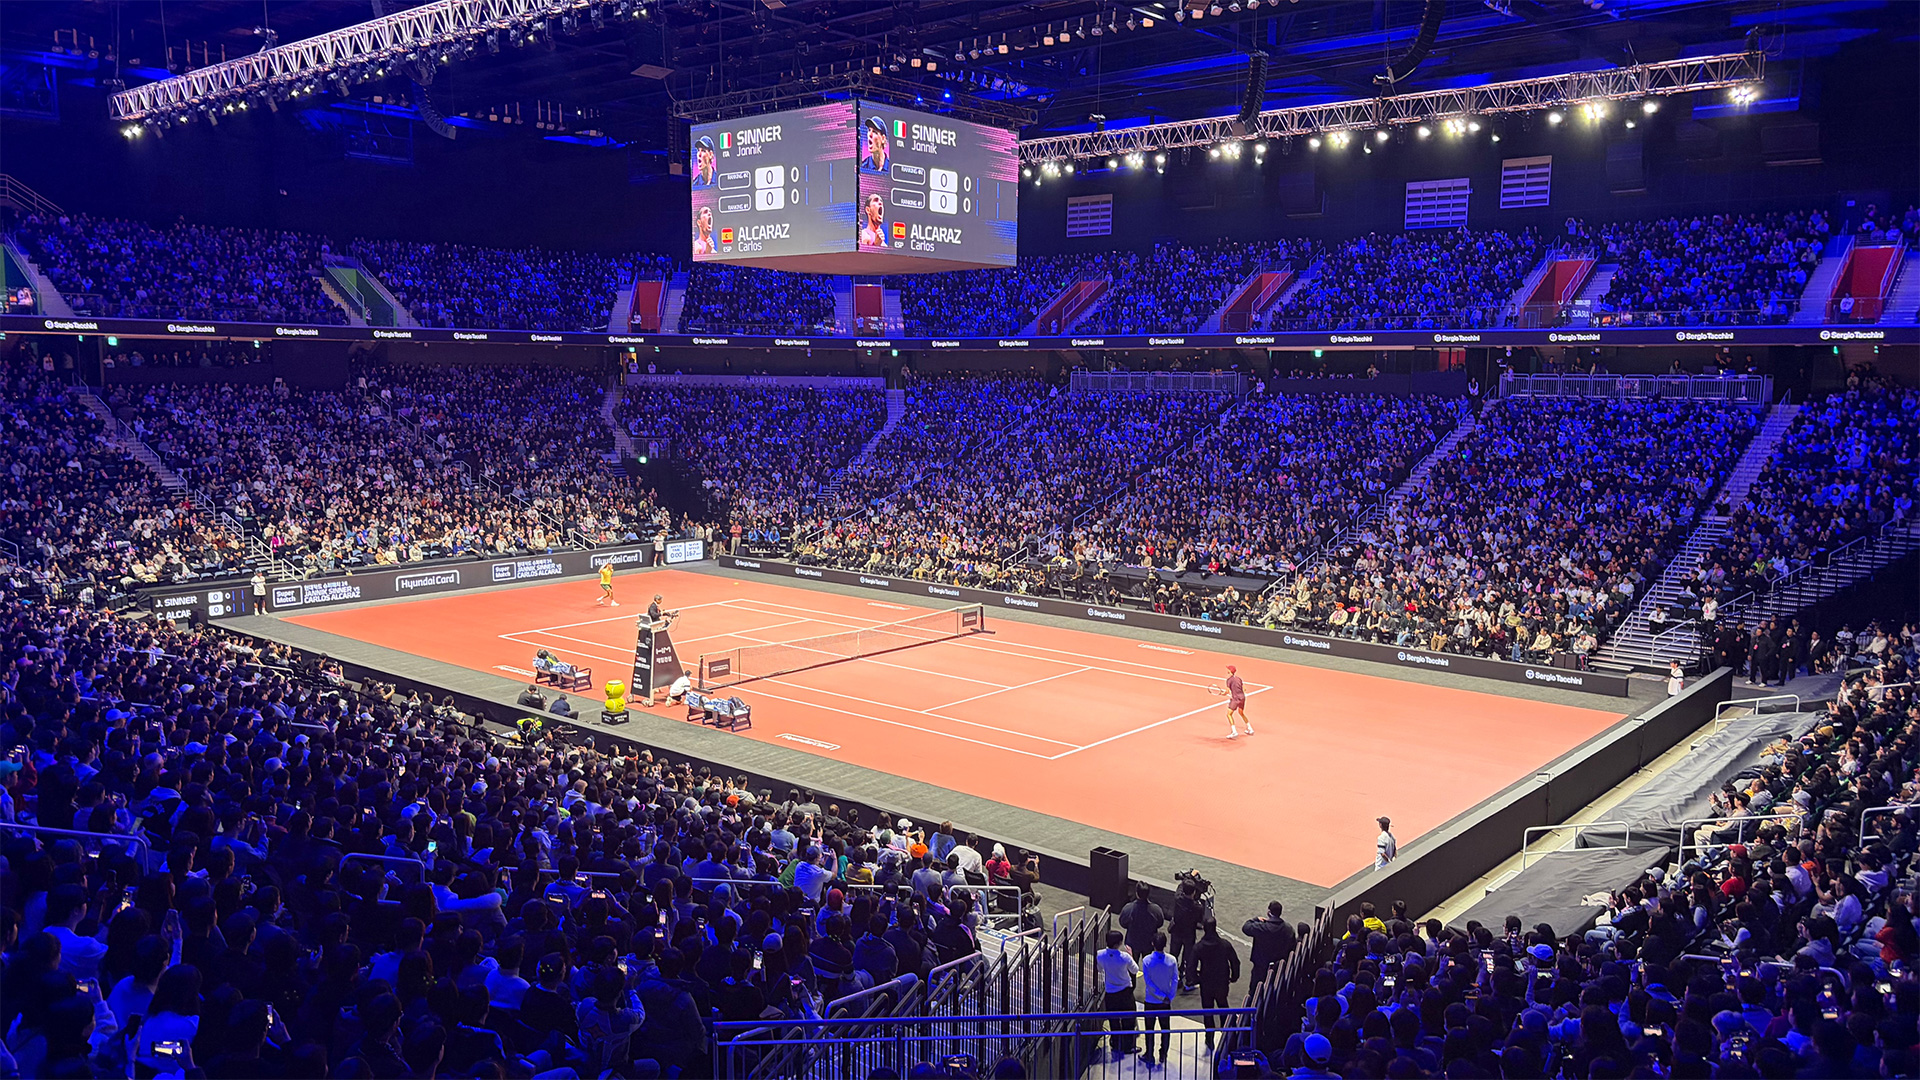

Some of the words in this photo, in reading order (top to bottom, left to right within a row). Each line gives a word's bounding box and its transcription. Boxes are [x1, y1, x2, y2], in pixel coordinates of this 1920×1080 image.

[737, 125, 781, 146] SINNER
[912, 124, 956, 147] SINNER
[737, 144, 762, 156] Jannik
[912, 140, 937, 154] Jannik
[766, 170, 773, 184] 0
[791, 167, 799, 182] 0
[941, 174, 947, 187] 0
[964, 176, 971, 192] 0
[766, 192, 773, 205] 0
[791, 188, 799, 204] 0
[940, 195, 947, 209] 0
[963, 198, 971, 212] 0
[738, 224, 790, 241] ALCARAZ
[910, 224, 961, 244] ALCARAZ
[738, 241, 762, 252] Carlos
[911, 240, 934, 252] Carlos
[54, 322, 72, 330] Sergio
[73, 322, 98, 330] Tacchini
[1558, 334, 1576, 342] Sergio
[1577, 334, 1600, 342] Tacchini
[1686, 332, 1707, 340] Sergio
[1707, 332, 1734, 340] Tacchini
[1831, 331, 1853, 340] Sergio
[1854, 331, 1884, 340] Tacchini
[623, 553, 638, 563] Card
[401, 576, 435, 589] Hyundai
[436, 574, 454, 584] Card
[329, 585, 352, 594] SINNER
[155, 599, 163, 608] J.
[164, 596, 198, 606] SINNER
[304, 595, 330, 604] CARLOS
[331, 591, 360, 600] ALCARAZ
[1108, 611, 1125, 619] Tacchini
[1187, 623, 1202, 631] Sergio
[1202, 625, 1221, 634] Tacchini
[1292, 638, 1308, 646] Sergio
[1308, 640, 1330, 649] Tacchini
[1407, 654, 1425, 663] Sergio
[1425, 657, 1449, 666] Tacchini
[1535, 672, 1556, 681] Sergio
[1556, 674, 1582, 685] Tacchini
